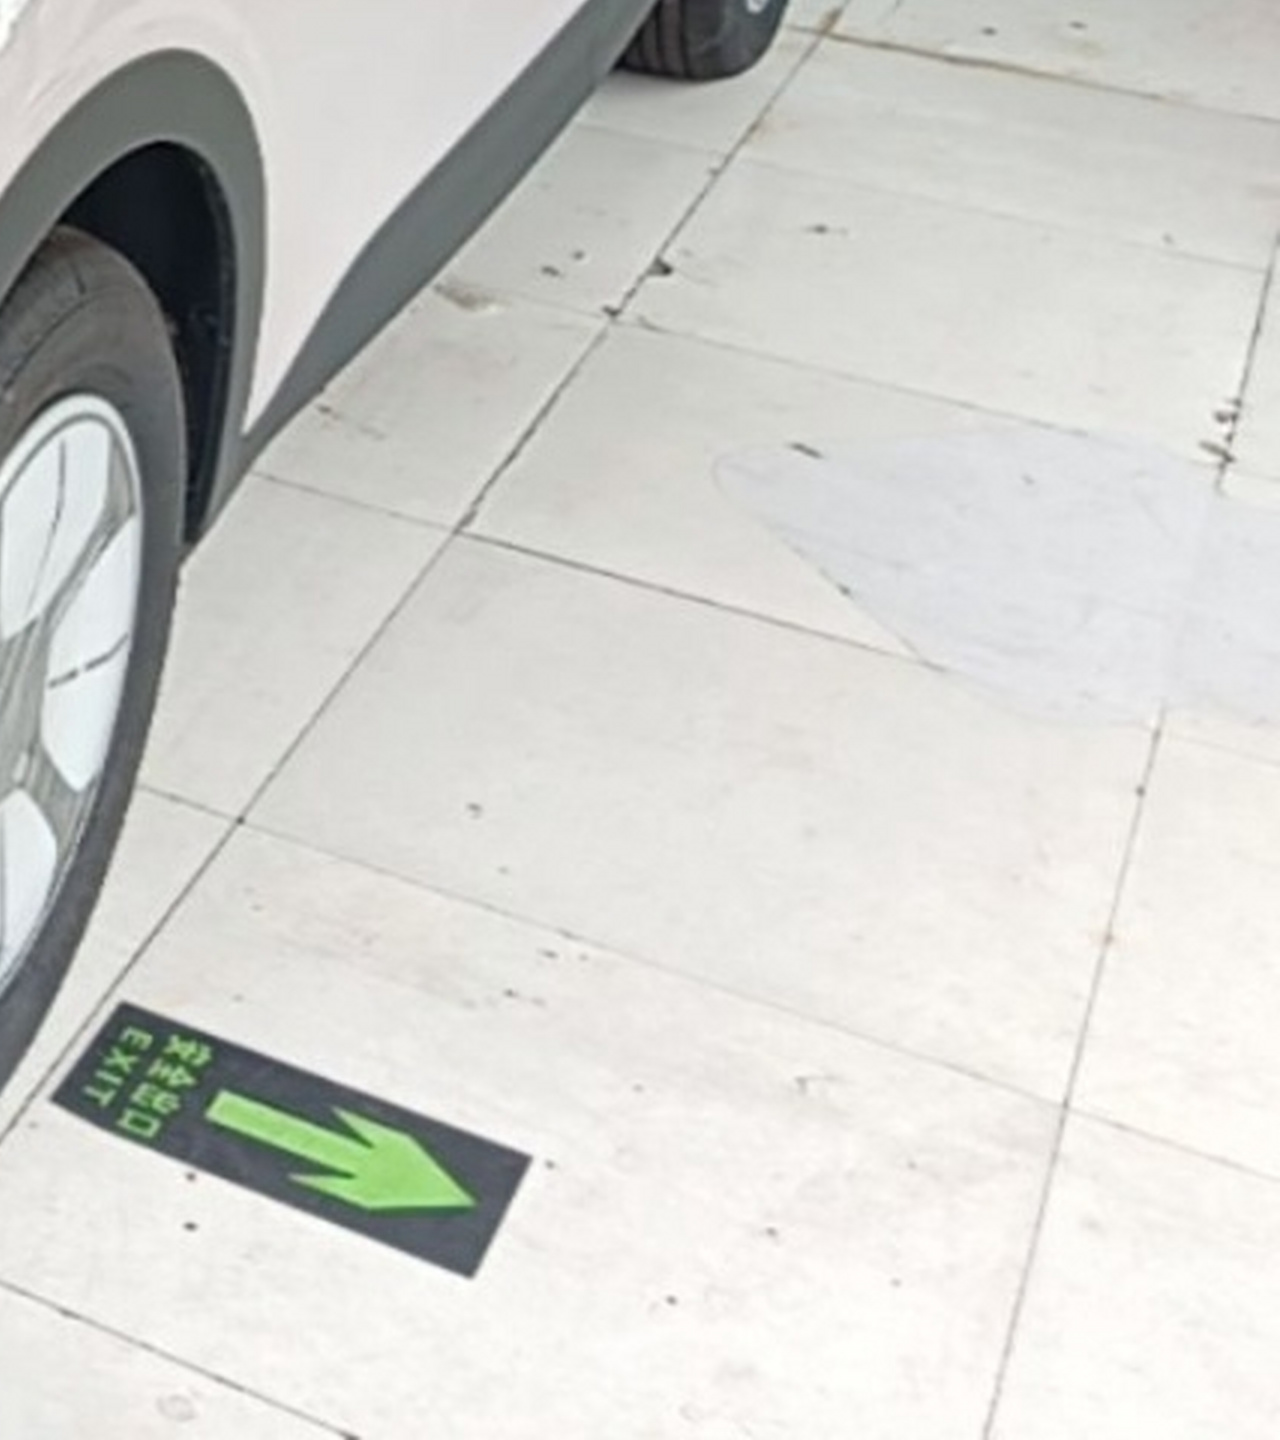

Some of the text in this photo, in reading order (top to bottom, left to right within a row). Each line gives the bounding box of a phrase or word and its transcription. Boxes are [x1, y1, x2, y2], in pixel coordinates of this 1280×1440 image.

[83, 1026, 154, 1108] EXIT
[117, 1033, 214, 1138] 安全出口
